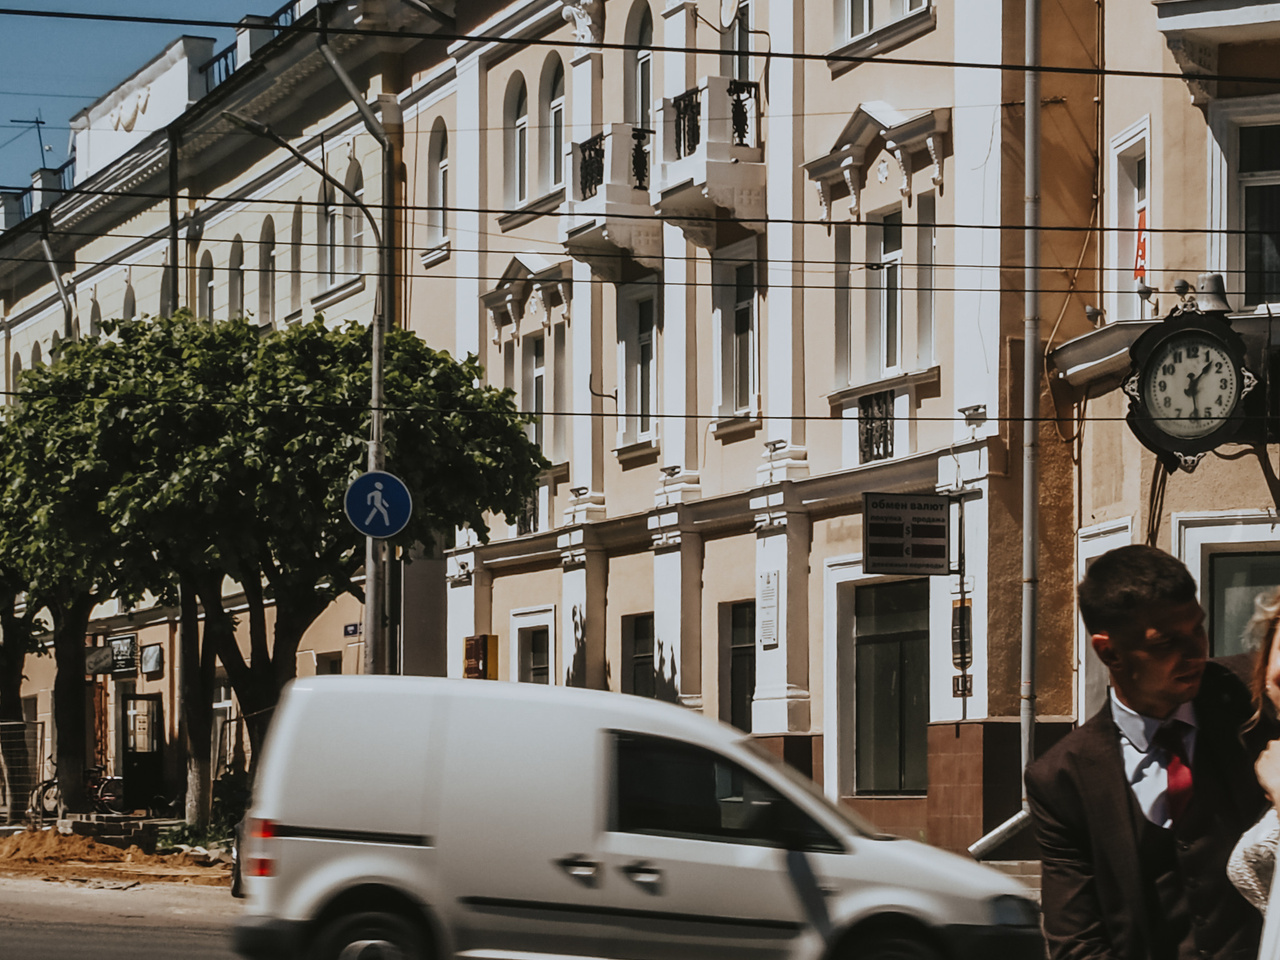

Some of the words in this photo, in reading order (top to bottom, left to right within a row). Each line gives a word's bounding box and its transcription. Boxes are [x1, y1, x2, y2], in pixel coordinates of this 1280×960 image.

[1173, 351, 1183, 364] 11
[1186, 346, 1200, 359] 12
[1205, 350, 1210, 362] 1
[1162, 363, 1176, 376] 10
[1215, 361, 1223, 374] 2
[1158, 380, 1167, 392] 9
[1219, 378, 1228, 390] 3
[1163, 396, 1172, 408] 8
[1215, 394, 1223, 407] 4
[1175, 408, 1183, 420] 7
[1204, 407, 1212, 419] 5
[871, 499, 908, 510] обмен
[910, 502, 945, 511] валют
